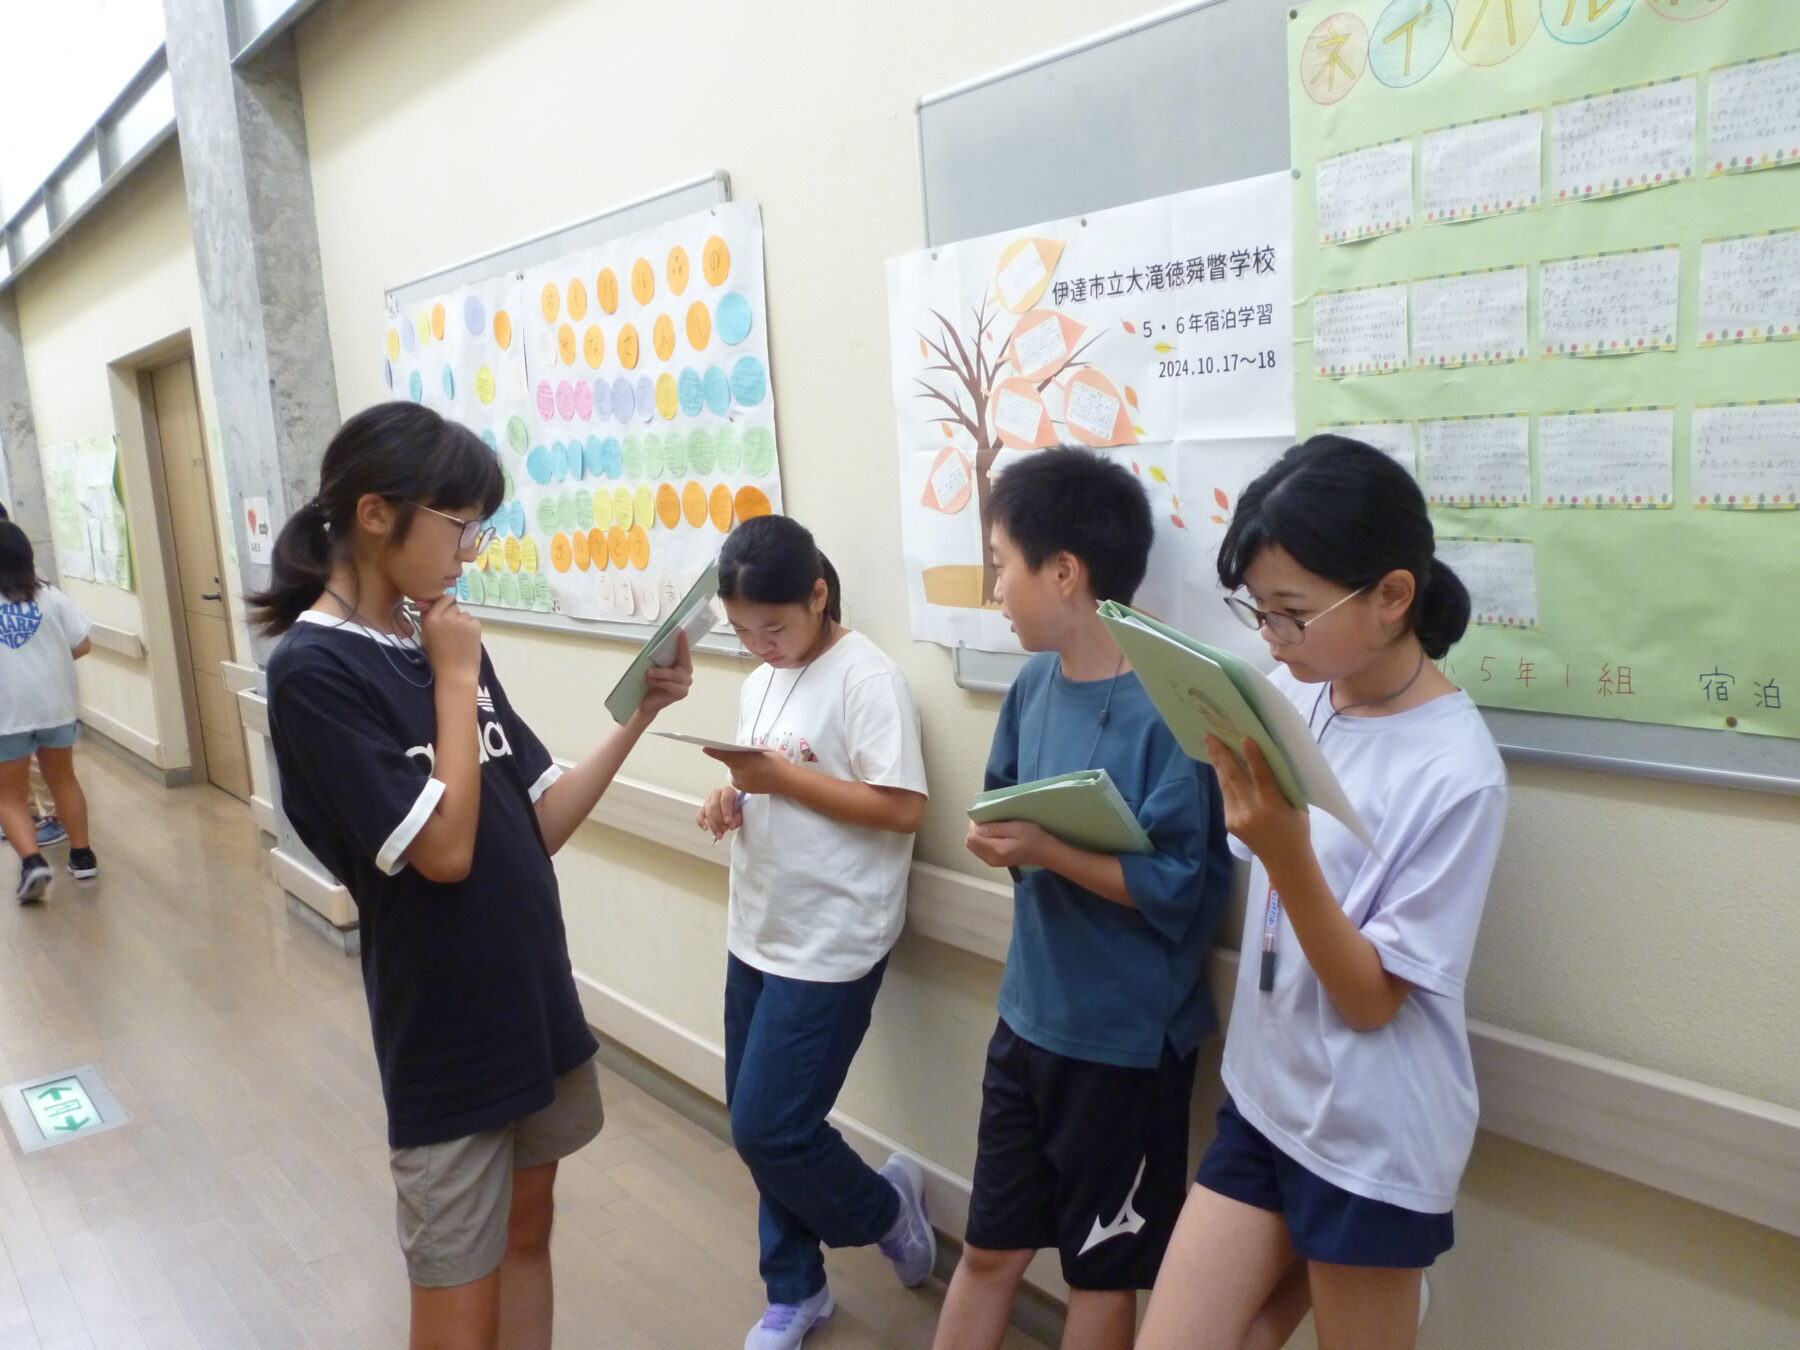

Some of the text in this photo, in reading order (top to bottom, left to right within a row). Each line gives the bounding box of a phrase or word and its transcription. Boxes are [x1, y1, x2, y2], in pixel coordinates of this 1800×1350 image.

[1052, 244, 1276, 306] 伊達市立大滝徳舜瞥学校
